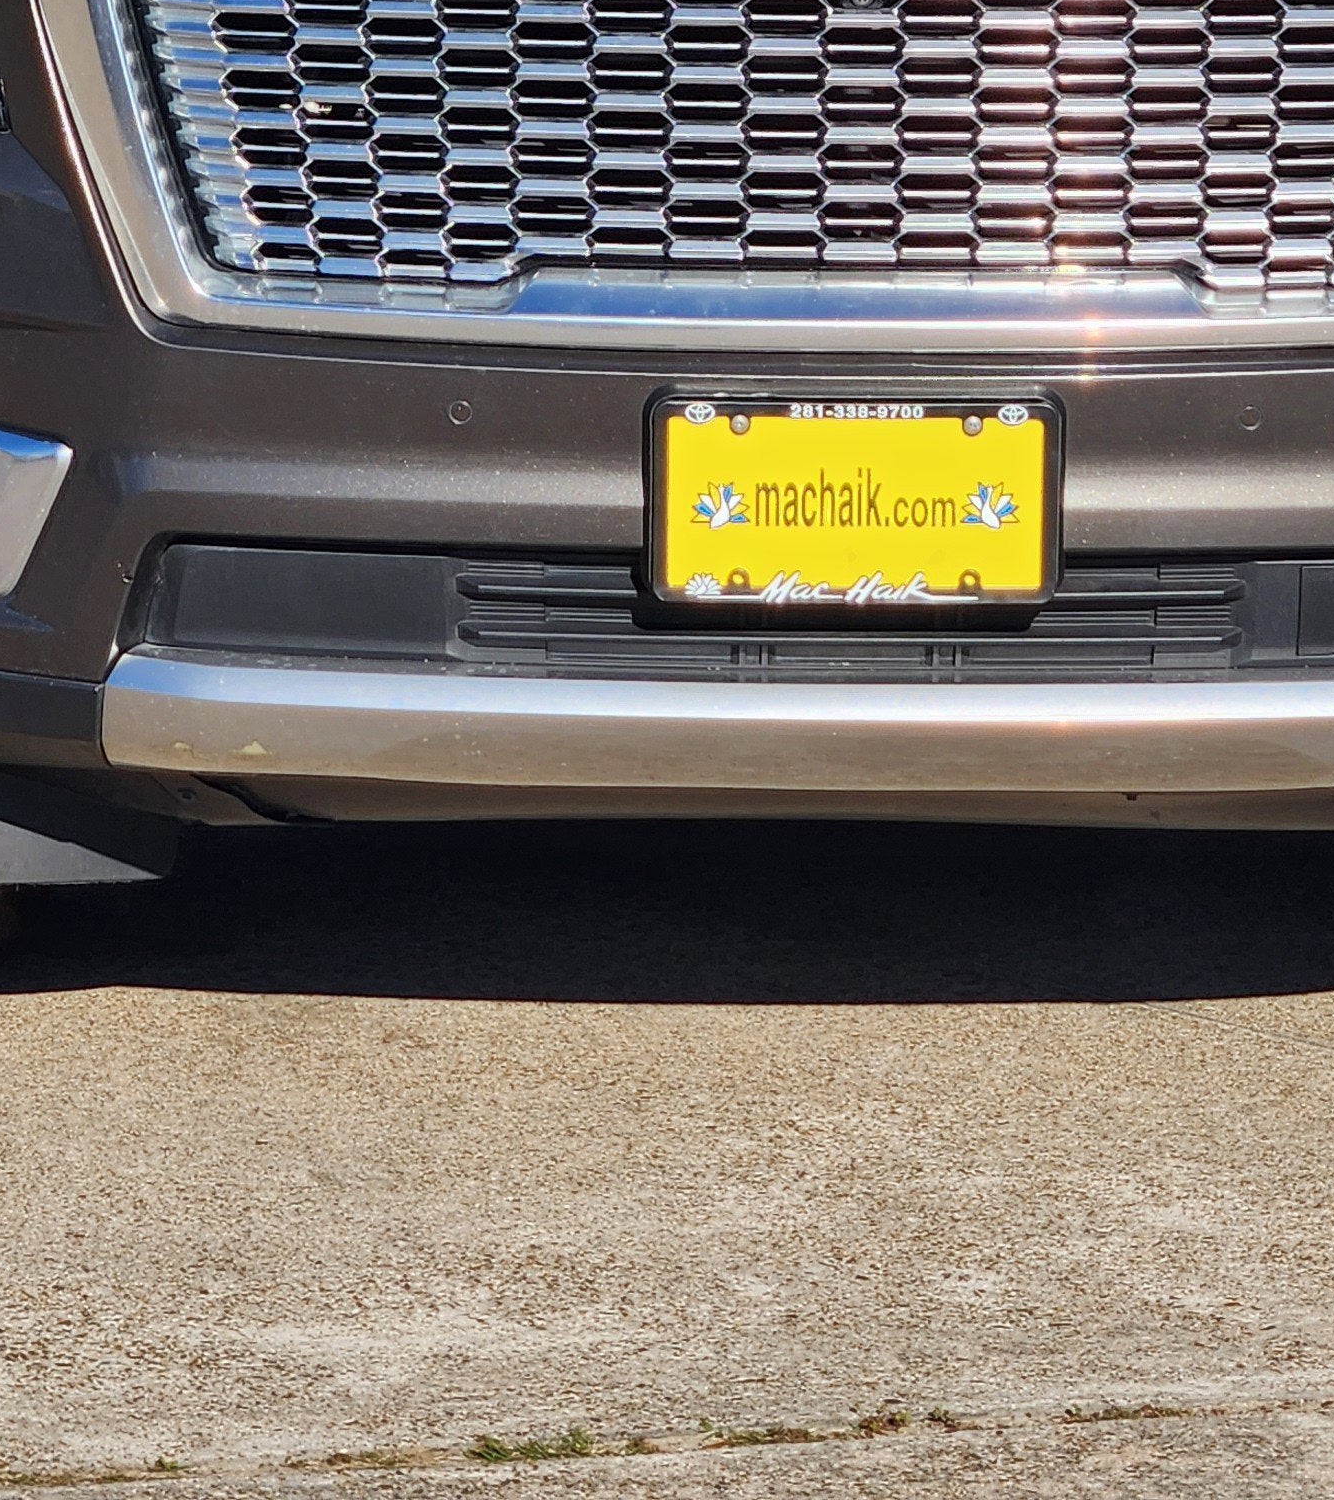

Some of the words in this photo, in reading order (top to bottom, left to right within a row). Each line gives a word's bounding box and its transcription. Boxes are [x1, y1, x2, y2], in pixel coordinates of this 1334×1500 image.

[790, 404, 924, 419] 281-338-9700
[755, 467, 957, 528] machaik.com
[760, 570, 831, 603] Mac
[845, 570, 929, 603] Haik
